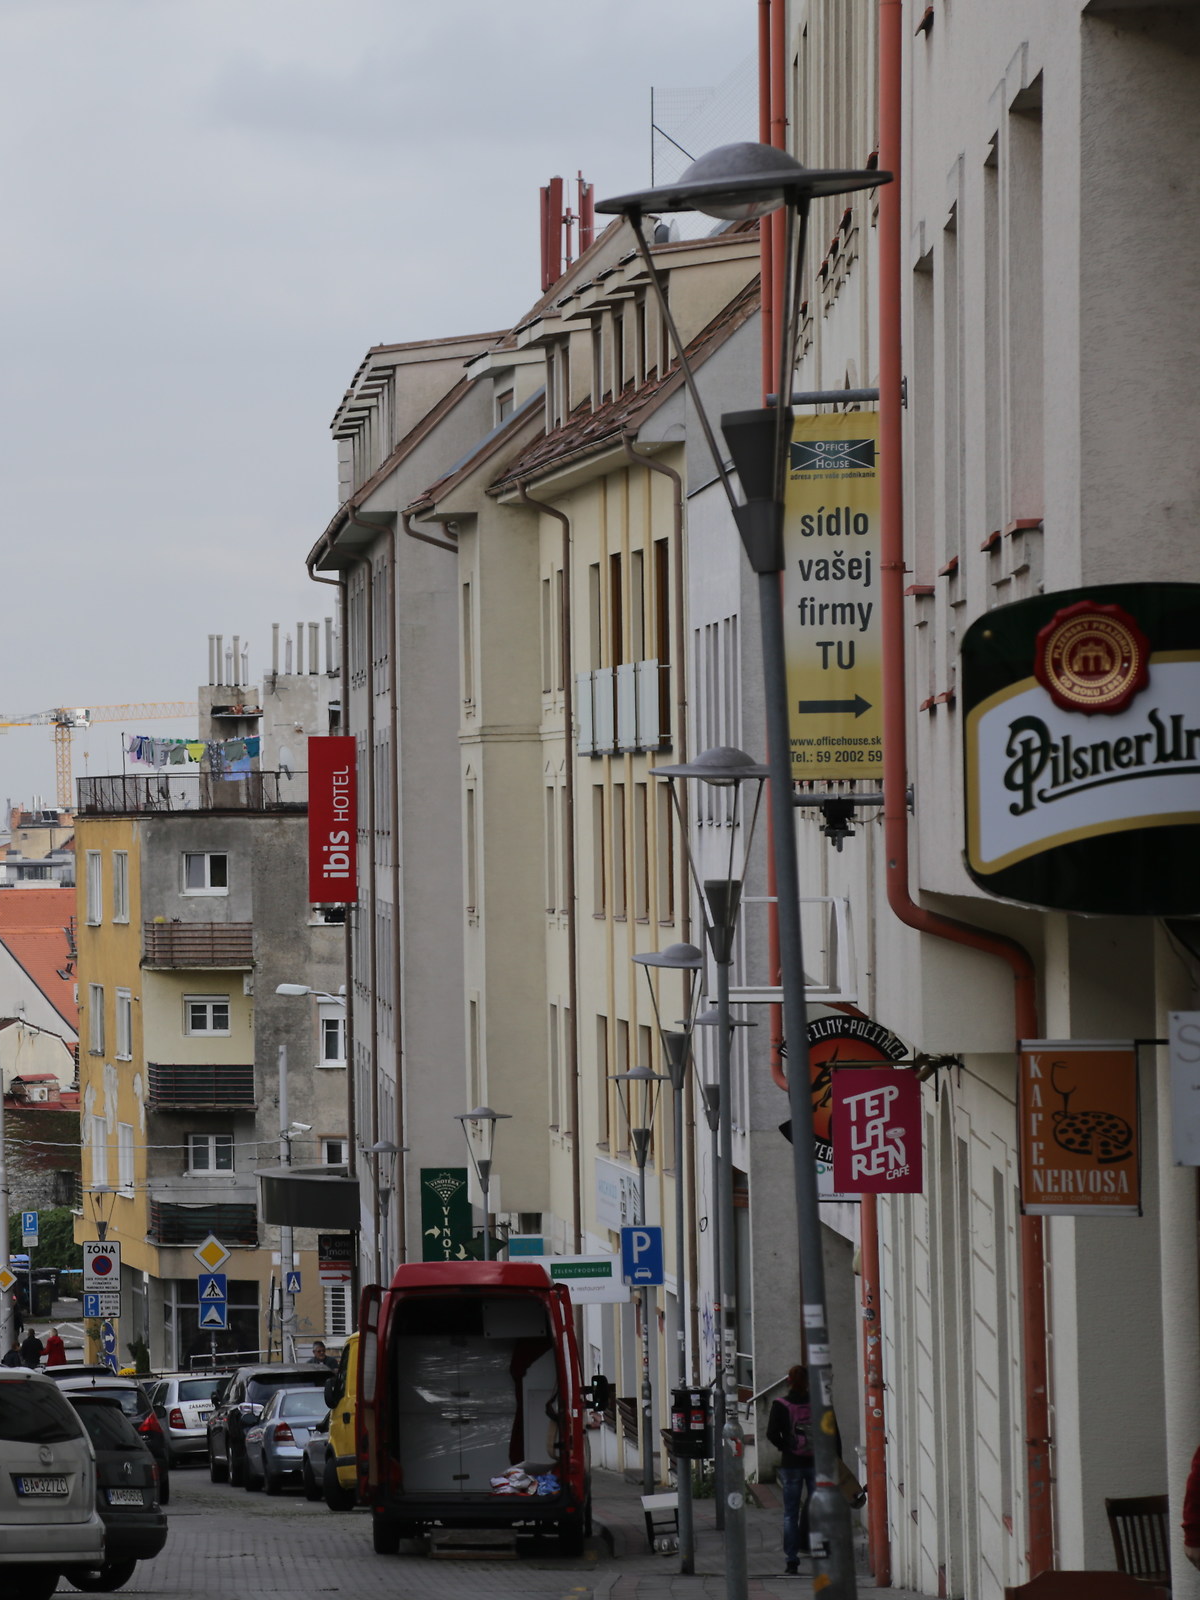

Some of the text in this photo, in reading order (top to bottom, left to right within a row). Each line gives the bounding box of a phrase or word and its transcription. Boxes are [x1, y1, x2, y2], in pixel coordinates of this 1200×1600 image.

[815, 442, 849, 452] OFFICE
[816, 460, 850, 469] HOUSE
[800, 506, 869, 537] sídlo
[798, 550, 872, 588] vašej
[798, 596, 873, 632] firmy
[816, 640, 855, 670] TU
[790, 736, 882, 747] www.officehouse.sk
[816, 750, 831, 762] 59
[835, 750, 864, 762] 2002
[868, 750, 882, 762] 59
[1004, 715, 1153, 816] Pilsner
[332, 765, 350, 822] HOTEL
[322, 830, 350, 878] ibis
[842, 1085, 899, 1122] TEP
[1030, 1055, 1044, 1166] KAFE
[851, 1119, 885, 1151] LA
[852, 1137, 906, 1181] REN
[1032, 1169, 1129, 1194] NERVOSA
[442, 1206, 452, 1262] VINOT
[632, 1231, 651, 1264] P
[87, 1296, 96, 1309] P
